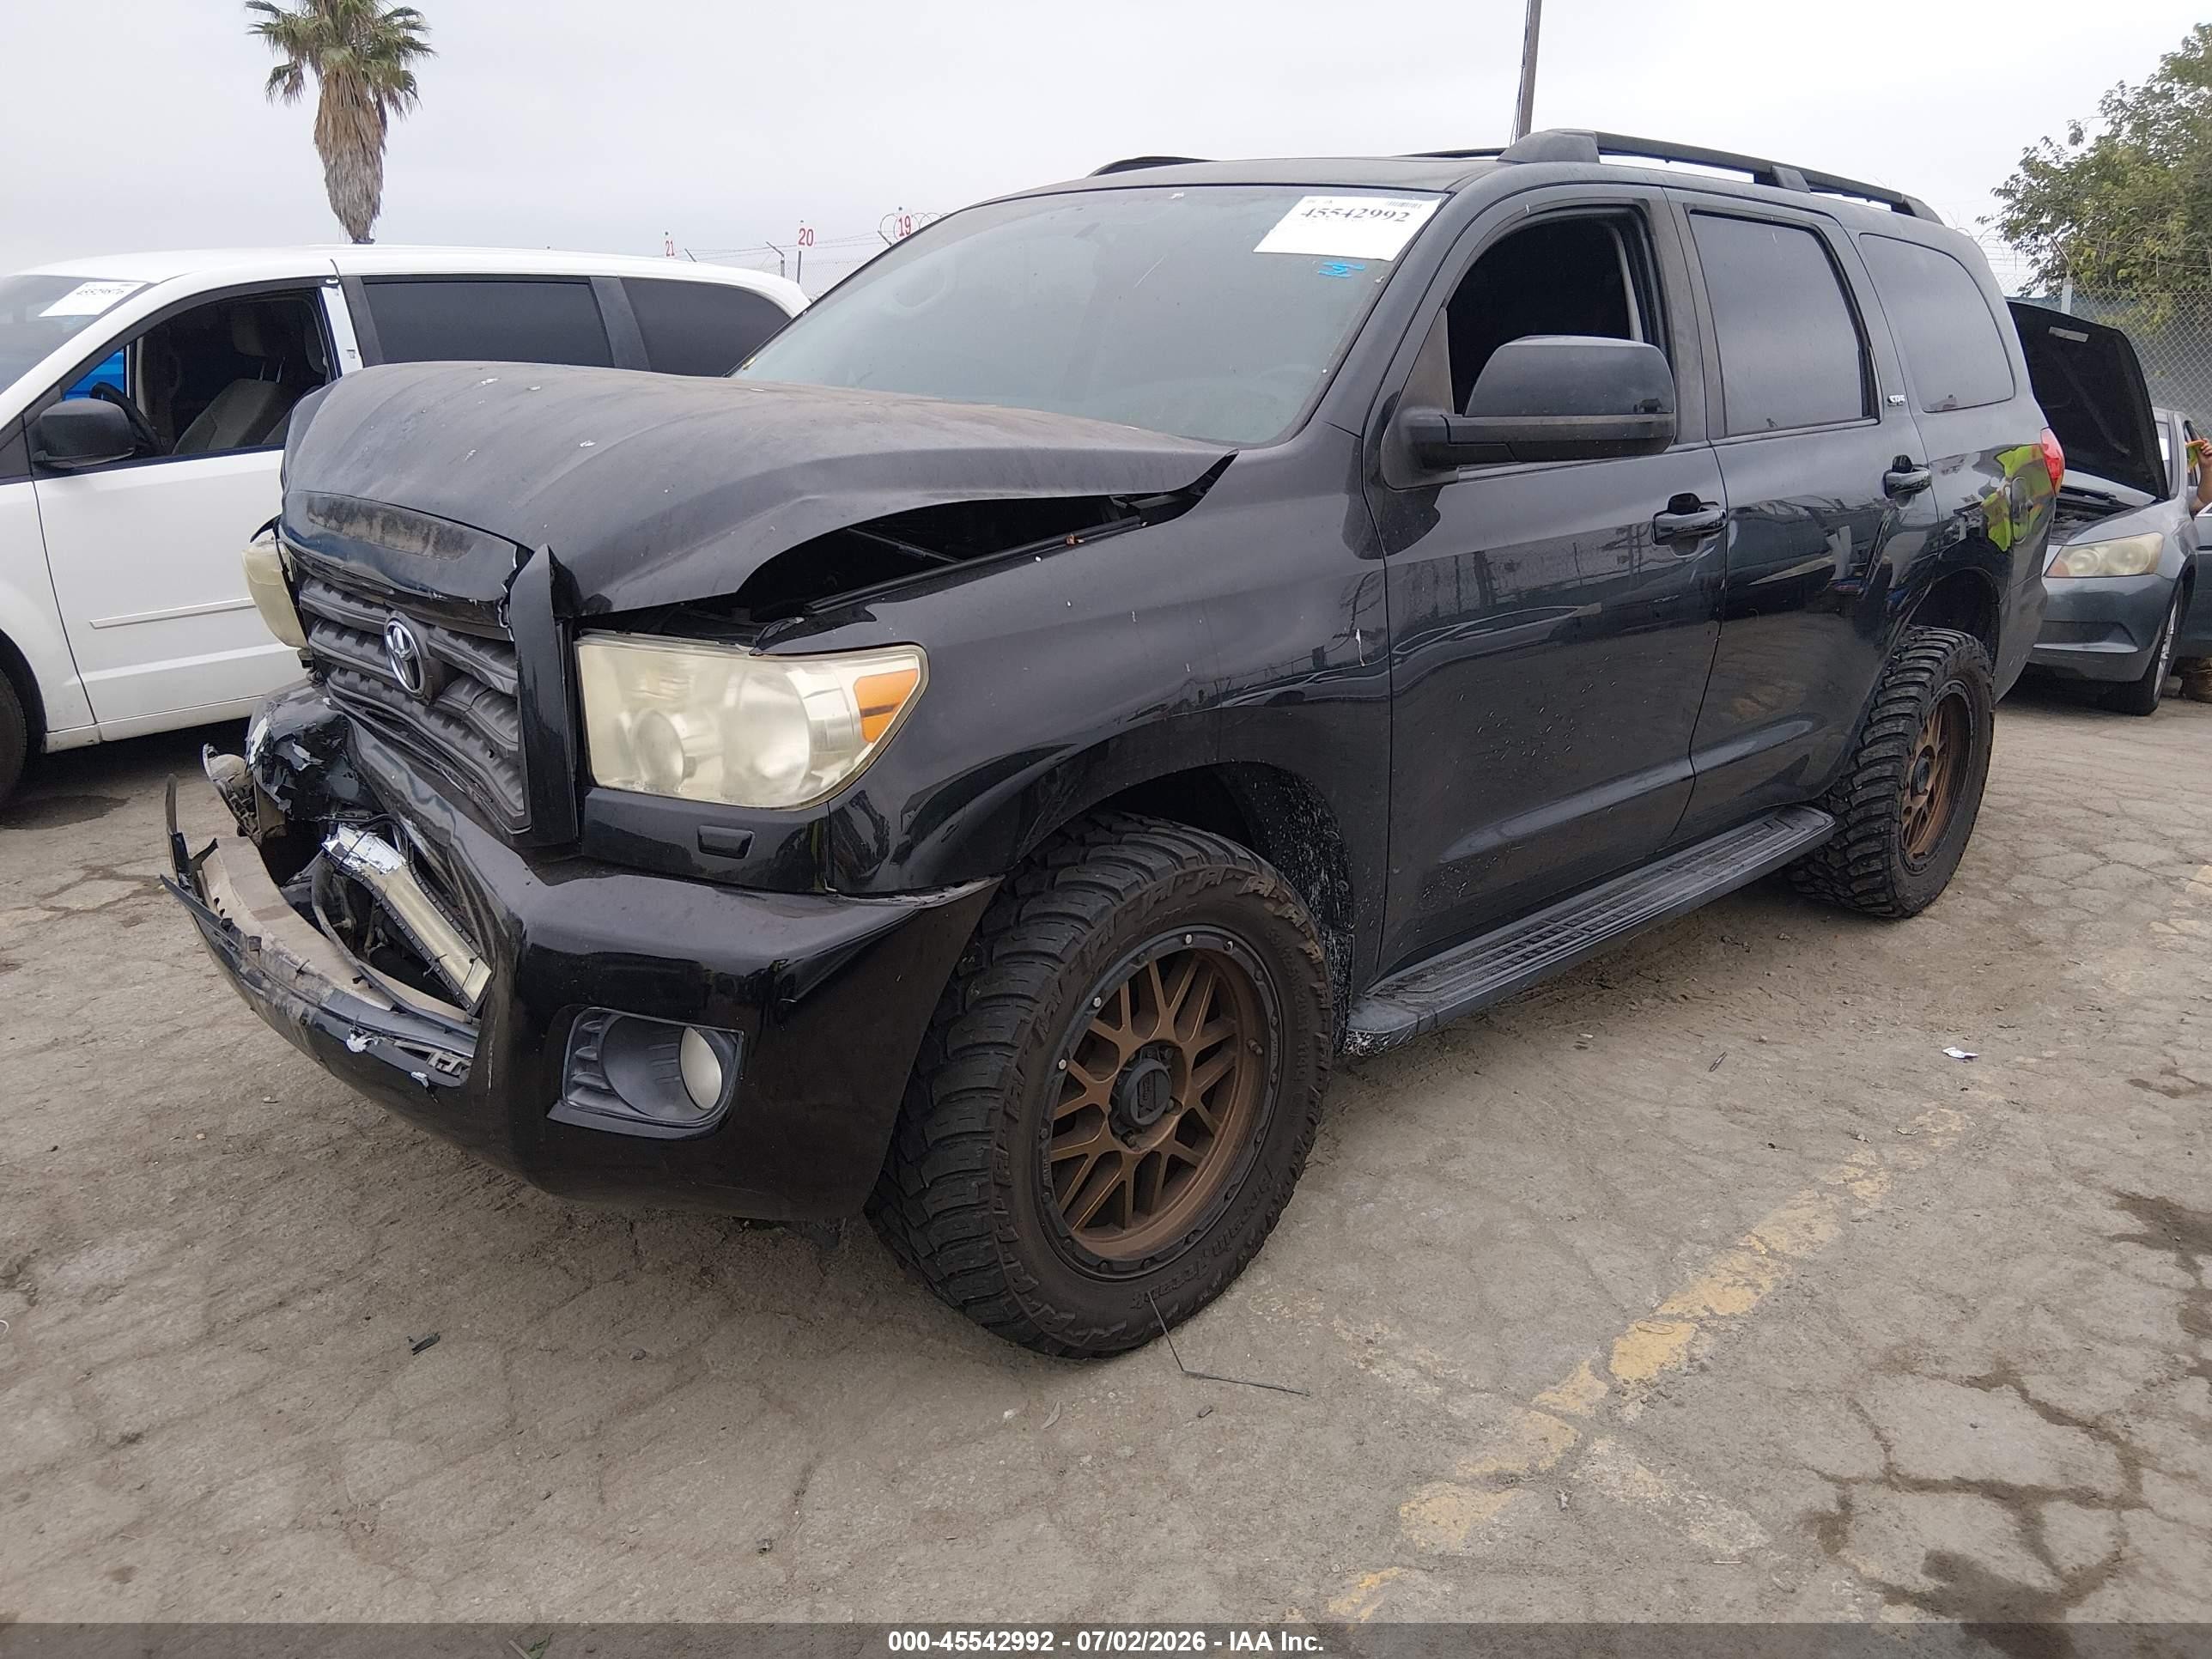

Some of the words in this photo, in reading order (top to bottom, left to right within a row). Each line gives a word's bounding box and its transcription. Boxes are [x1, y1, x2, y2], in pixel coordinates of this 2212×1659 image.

[1300, 208, 1411, 222] 45542992
[898, 216, 912, 238] 19
[798, 228, 814, 247] 20
[665, 240, 676, 258] 21
